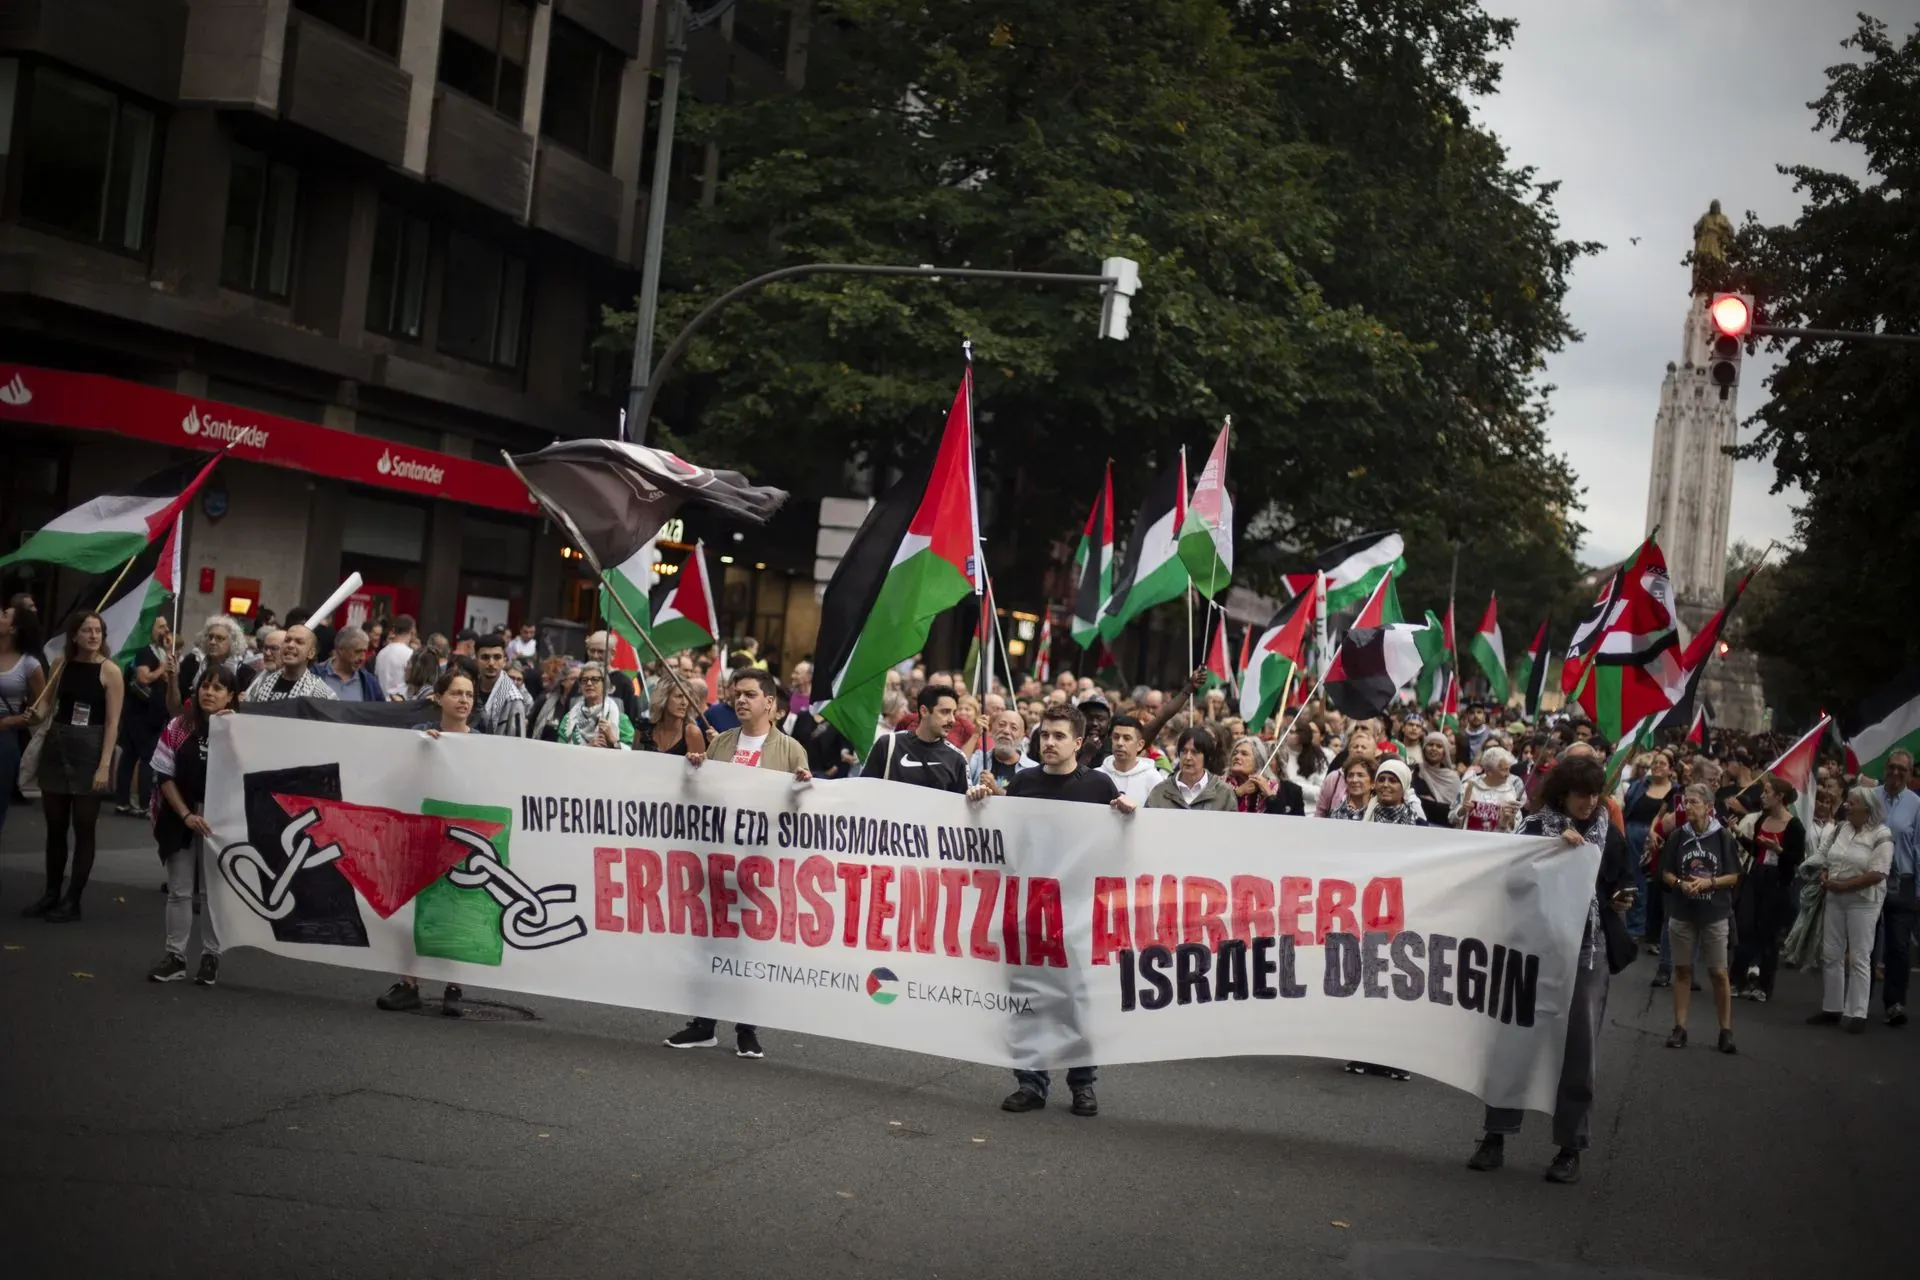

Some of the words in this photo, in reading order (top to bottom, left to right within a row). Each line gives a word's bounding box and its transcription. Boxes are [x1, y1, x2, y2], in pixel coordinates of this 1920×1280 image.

[200, 413, 270, 449] Santander
[391, 455, 444, 484] Santander
[521, 794, 727, 844] INPERIALISMOAREN
[734, 808, 769, 846] ETA
[778, 811, 930, 859] SIONISMOAREN
[936, 826, 1006, 865] AURKA
[593, 846, 1069, 969] ERRESISTENTZIA
[1091, 873, 1405, 966] AURRERA
[711, 956, 860, 993] PALESTINAREKIN
[907, 980, 1036, 1015] ELKARTASUNA
[1120, 934, 1308, 1013] ISRAEL
[1323, 930, 1540, 1028] DESEGIN
